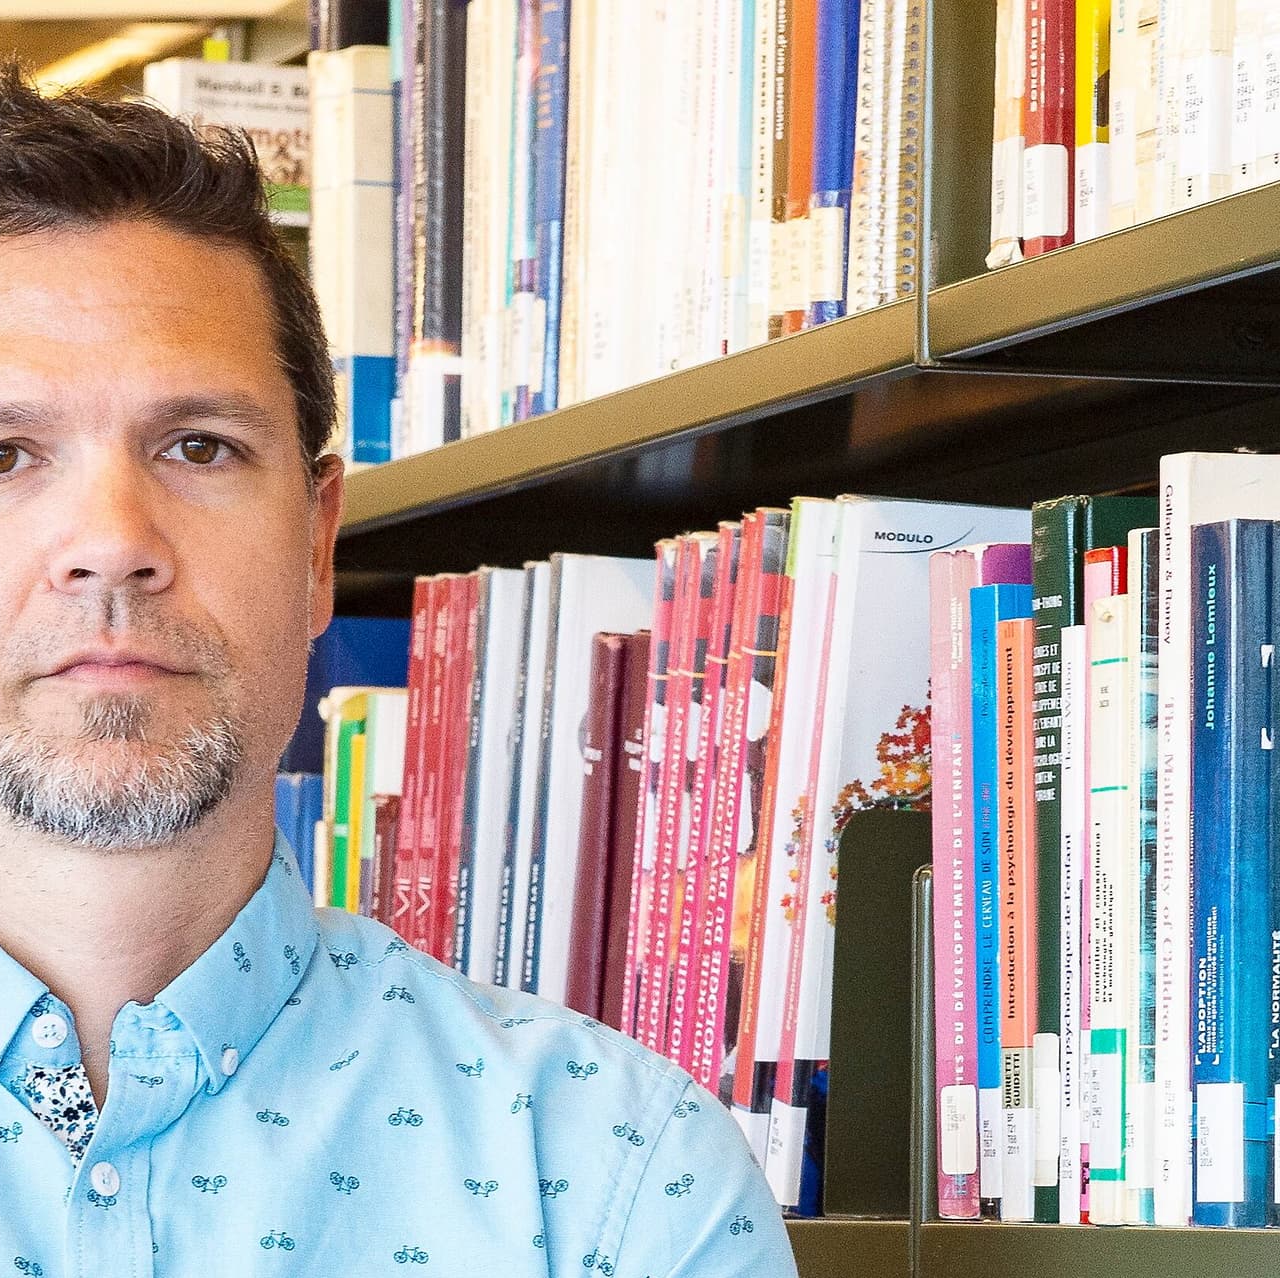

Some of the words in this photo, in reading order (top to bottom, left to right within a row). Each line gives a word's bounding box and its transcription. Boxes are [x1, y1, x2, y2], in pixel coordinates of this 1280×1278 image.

[873, 530, 934, 545] MODULO
[1163, 484, 1175, 565] Gallagher
[1165, 570, 1175, 583] &
[1163, 588, 1175, 646] Ramey
[1204, 563, 1218, 645] Lemieux
[1004, 647, 1018, 766] développement
[1203, 651, 1216, 731] Johanne
[1163, 697, 1175, 743] The
[1004, 771, 1015, 790] du
[953, 827, 964, 849] DE
[980, 831, 992, 855] SON
[1005, 792, 1019, 886] psychologie
[1161, 753, 1175, 897] Malleability
[980, 857, 993, 872] DE
[980, 879, 993, 929] CERVEAU
[1005, 891, 1016, 906] la
[1163, 905, 1175, 930] of
[951, 858, 965, 1012] DÉVELOPPEMENT
[982, 934, 993, 949] LE
[1005, 923, 1017, 1020] Introduction
[1162, 938, 1175, 1043] Children
[982, 959, 996, 1045] COMPRENDRE
[1197, 957, 1208, 1055] L'ADOPTION
[953, 1022, 965, 1045] DU
[1012, 1053, 1021, 1107] GUIDETTI
